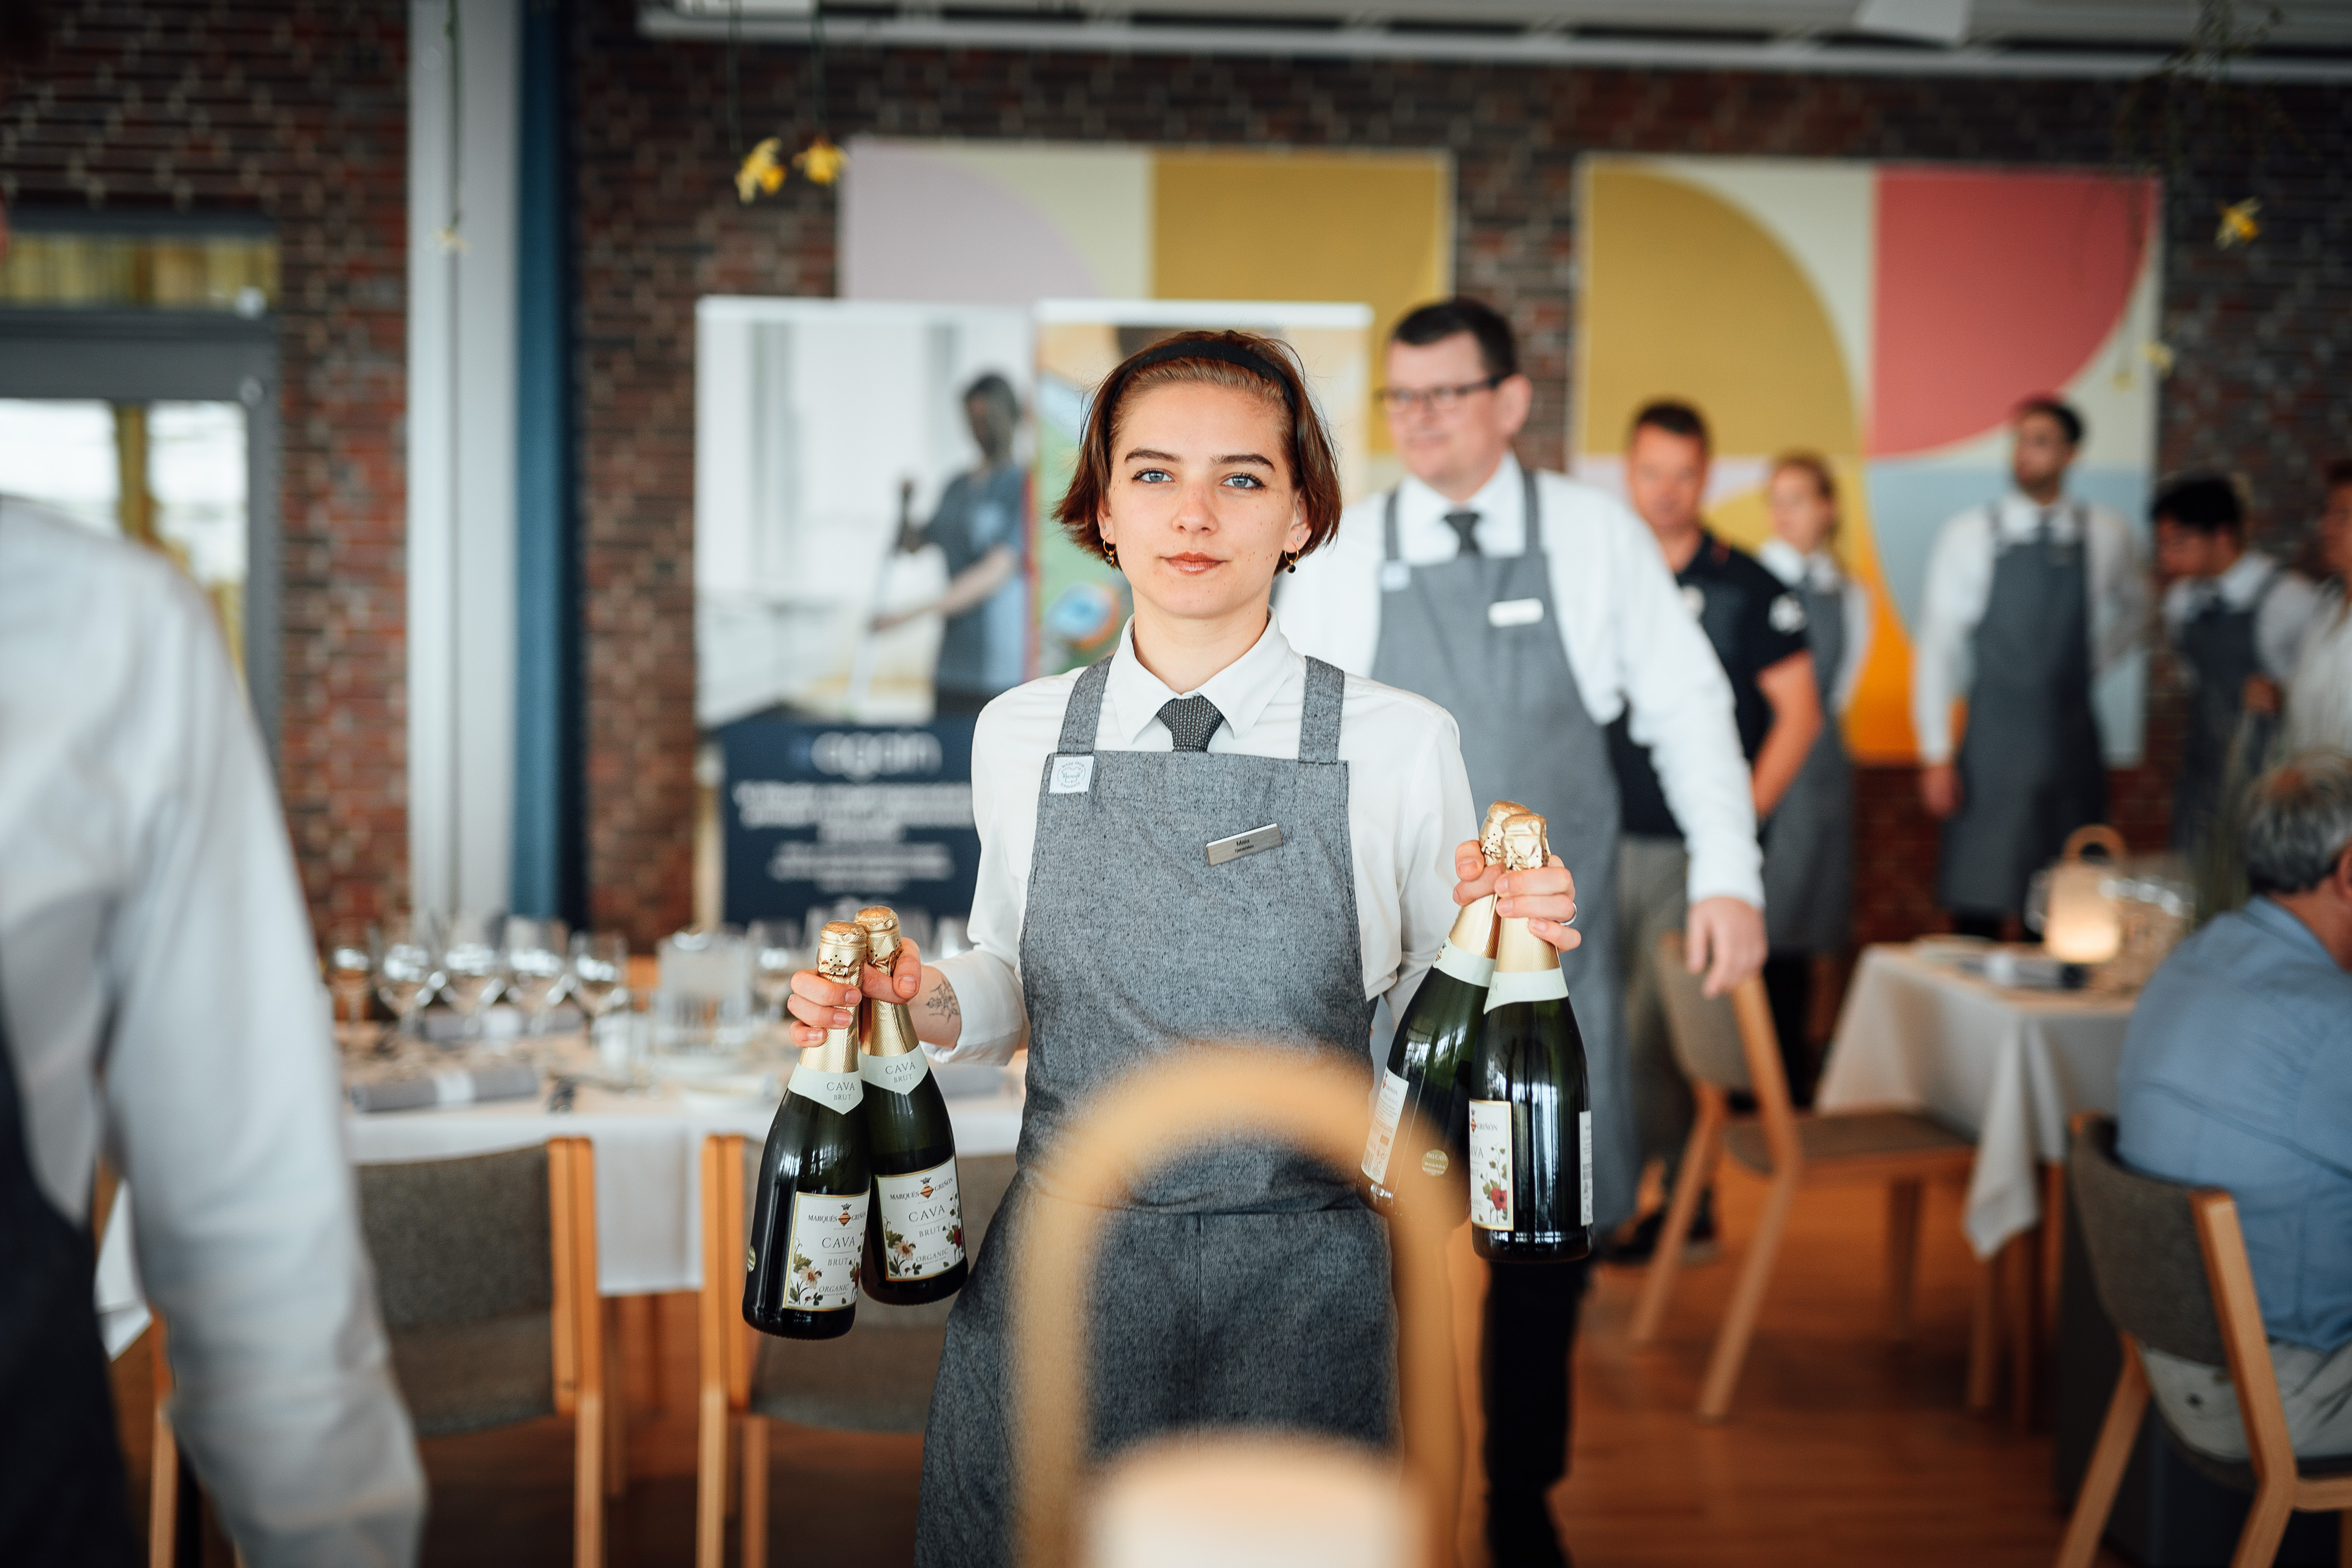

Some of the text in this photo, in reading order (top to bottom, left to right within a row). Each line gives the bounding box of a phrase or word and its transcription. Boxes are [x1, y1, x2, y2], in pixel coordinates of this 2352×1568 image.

[885, 1062, 916, 1075] CAVA
[894, 1074, 913, 1083] BRUT
[826, 1081, 855, 1091] CAVA
[890, 1190, 920, 1201] MARQUÉS
[808, 1214, 837, 1223] MARQUÉS
[908, 1204, 945, 1223] CAVA
[919, 1225, 941, 1238] BRUT
[822, 1236, 855, 1249] CAVA
[916, 1247, 949, 1263] ORGANIC
[827, 1257, 848, 1266] BRUT
[818, 1284, 849, 1293] ORGANIC
